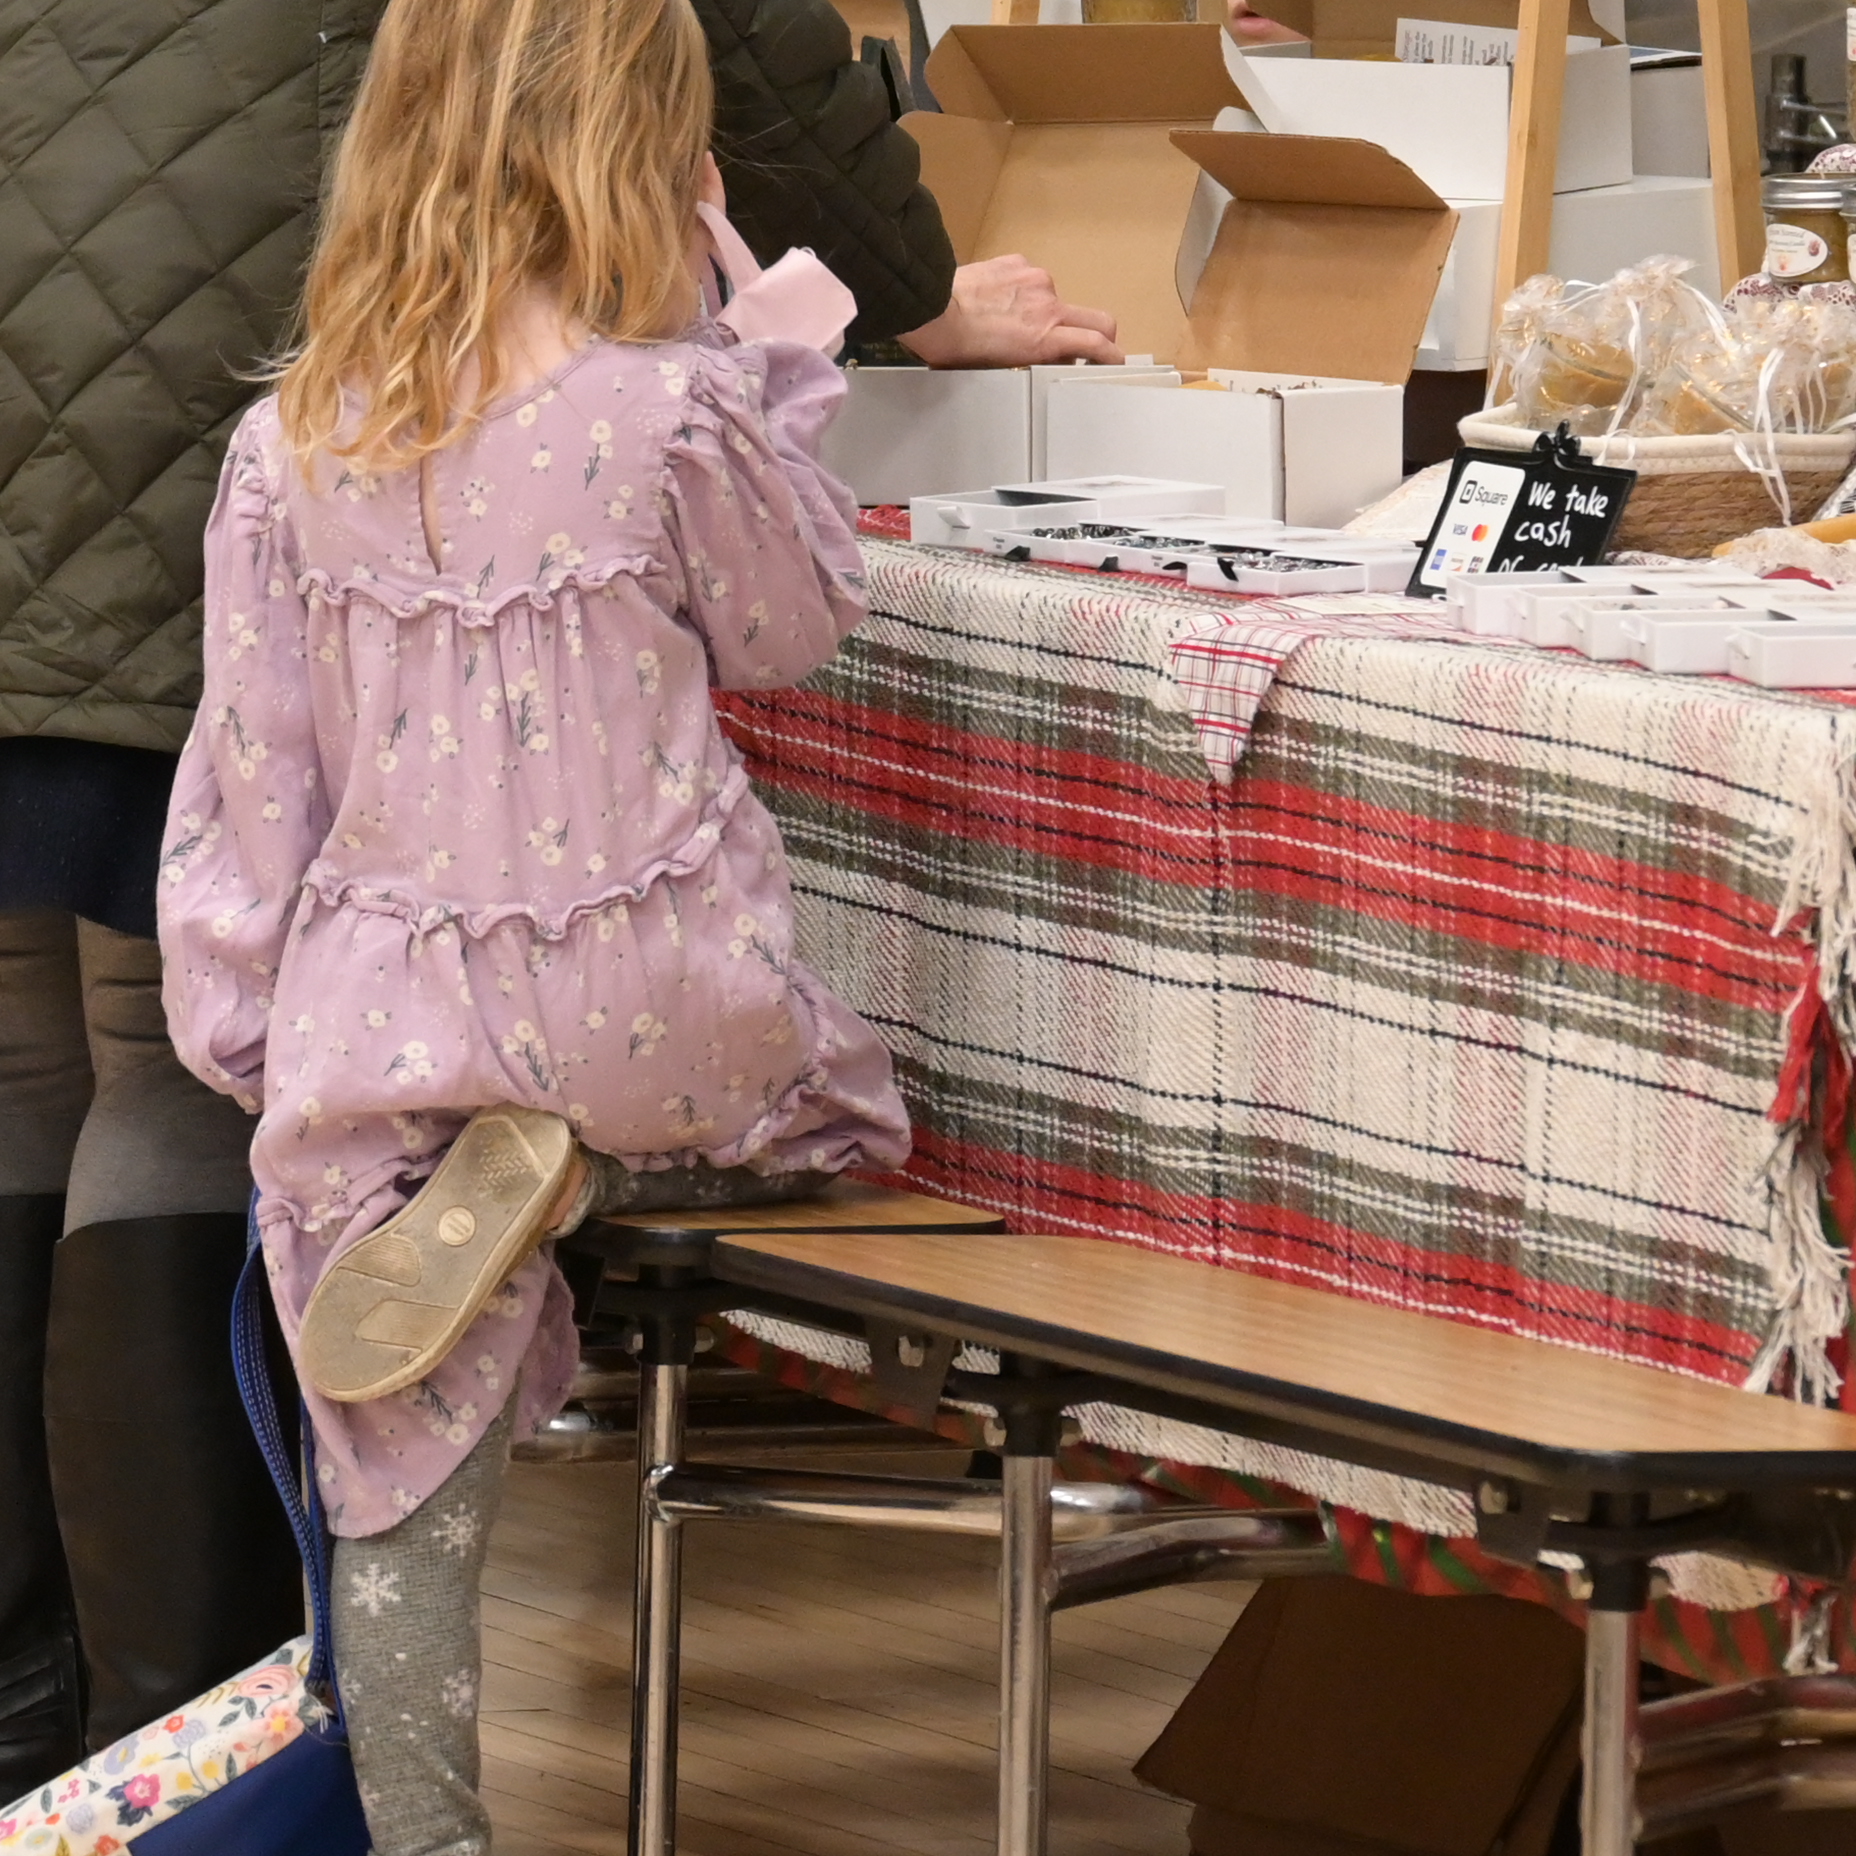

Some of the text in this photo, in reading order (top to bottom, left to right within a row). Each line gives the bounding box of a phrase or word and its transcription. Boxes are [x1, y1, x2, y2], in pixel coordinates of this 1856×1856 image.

[1474, 486, 1509, 508] Square
[1528, 481, 1609, 518] We take
[1452, 523, 1469, 536] VISA
[1514, 514, 1572, 549] cash
